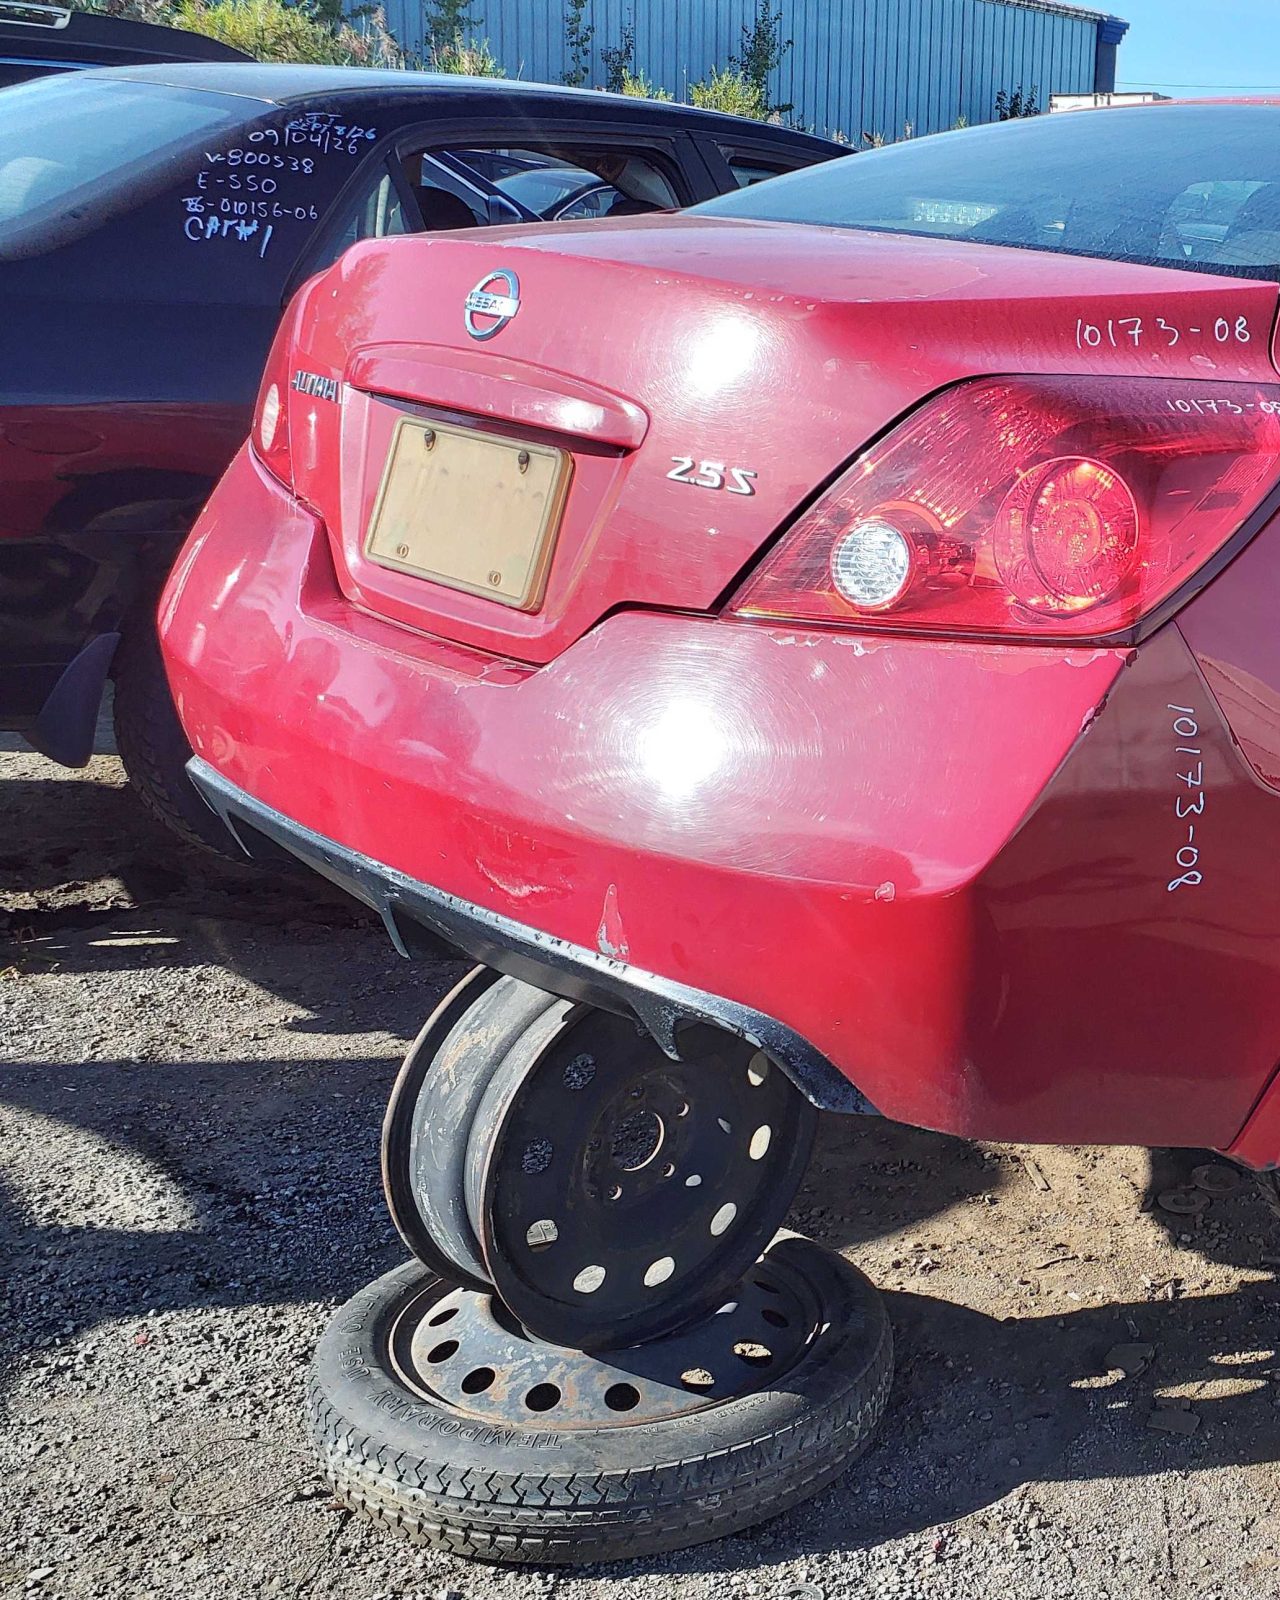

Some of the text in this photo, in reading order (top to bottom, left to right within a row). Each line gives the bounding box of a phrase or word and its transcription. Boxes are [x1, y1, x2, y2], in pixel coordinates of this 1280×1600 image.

[1167, 703, 1205, 892] 10173-08
[337, 1344, 372, 1384] USE
[366, 1388, 563, 1451] TEMPORARY
